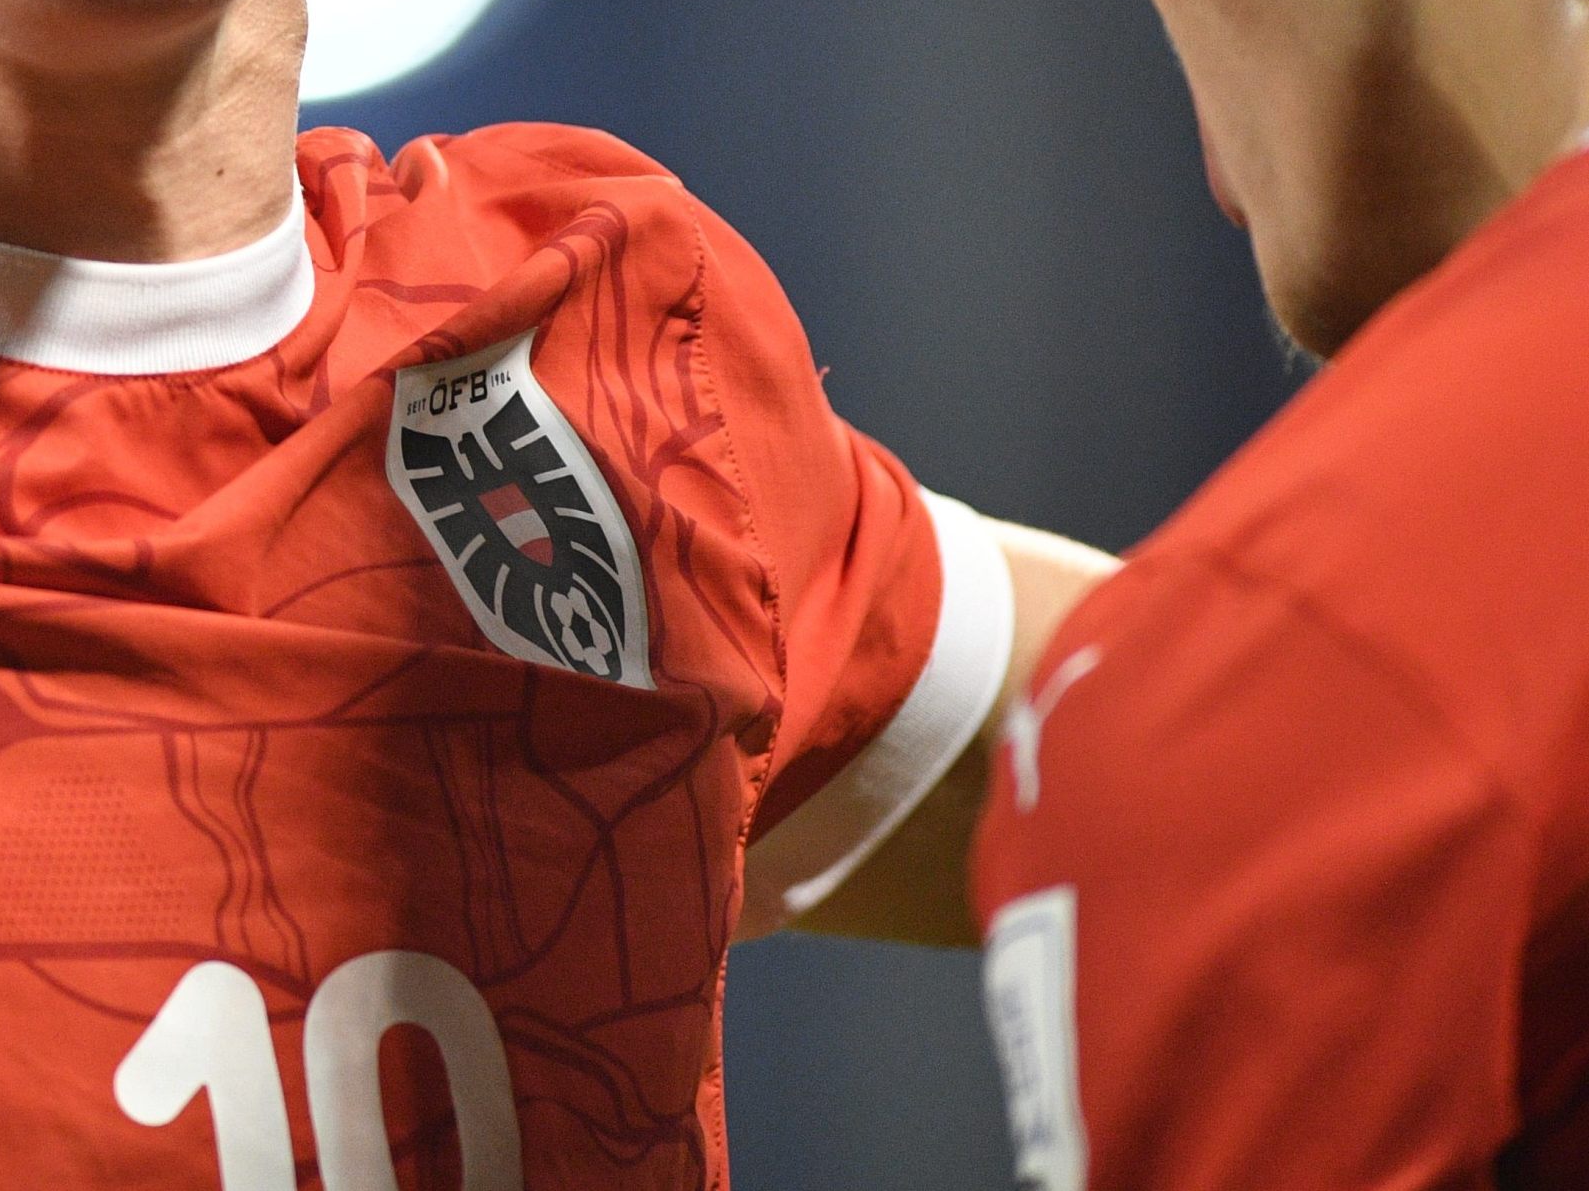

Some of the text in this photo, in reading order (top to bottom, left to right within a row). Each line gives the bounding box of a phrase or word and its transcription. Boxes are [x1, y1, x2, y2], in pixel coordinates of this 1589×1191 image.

[406, 369, 511, 416] SEIT ÖFB 1904
[113, 949, 525, 1191] 10
